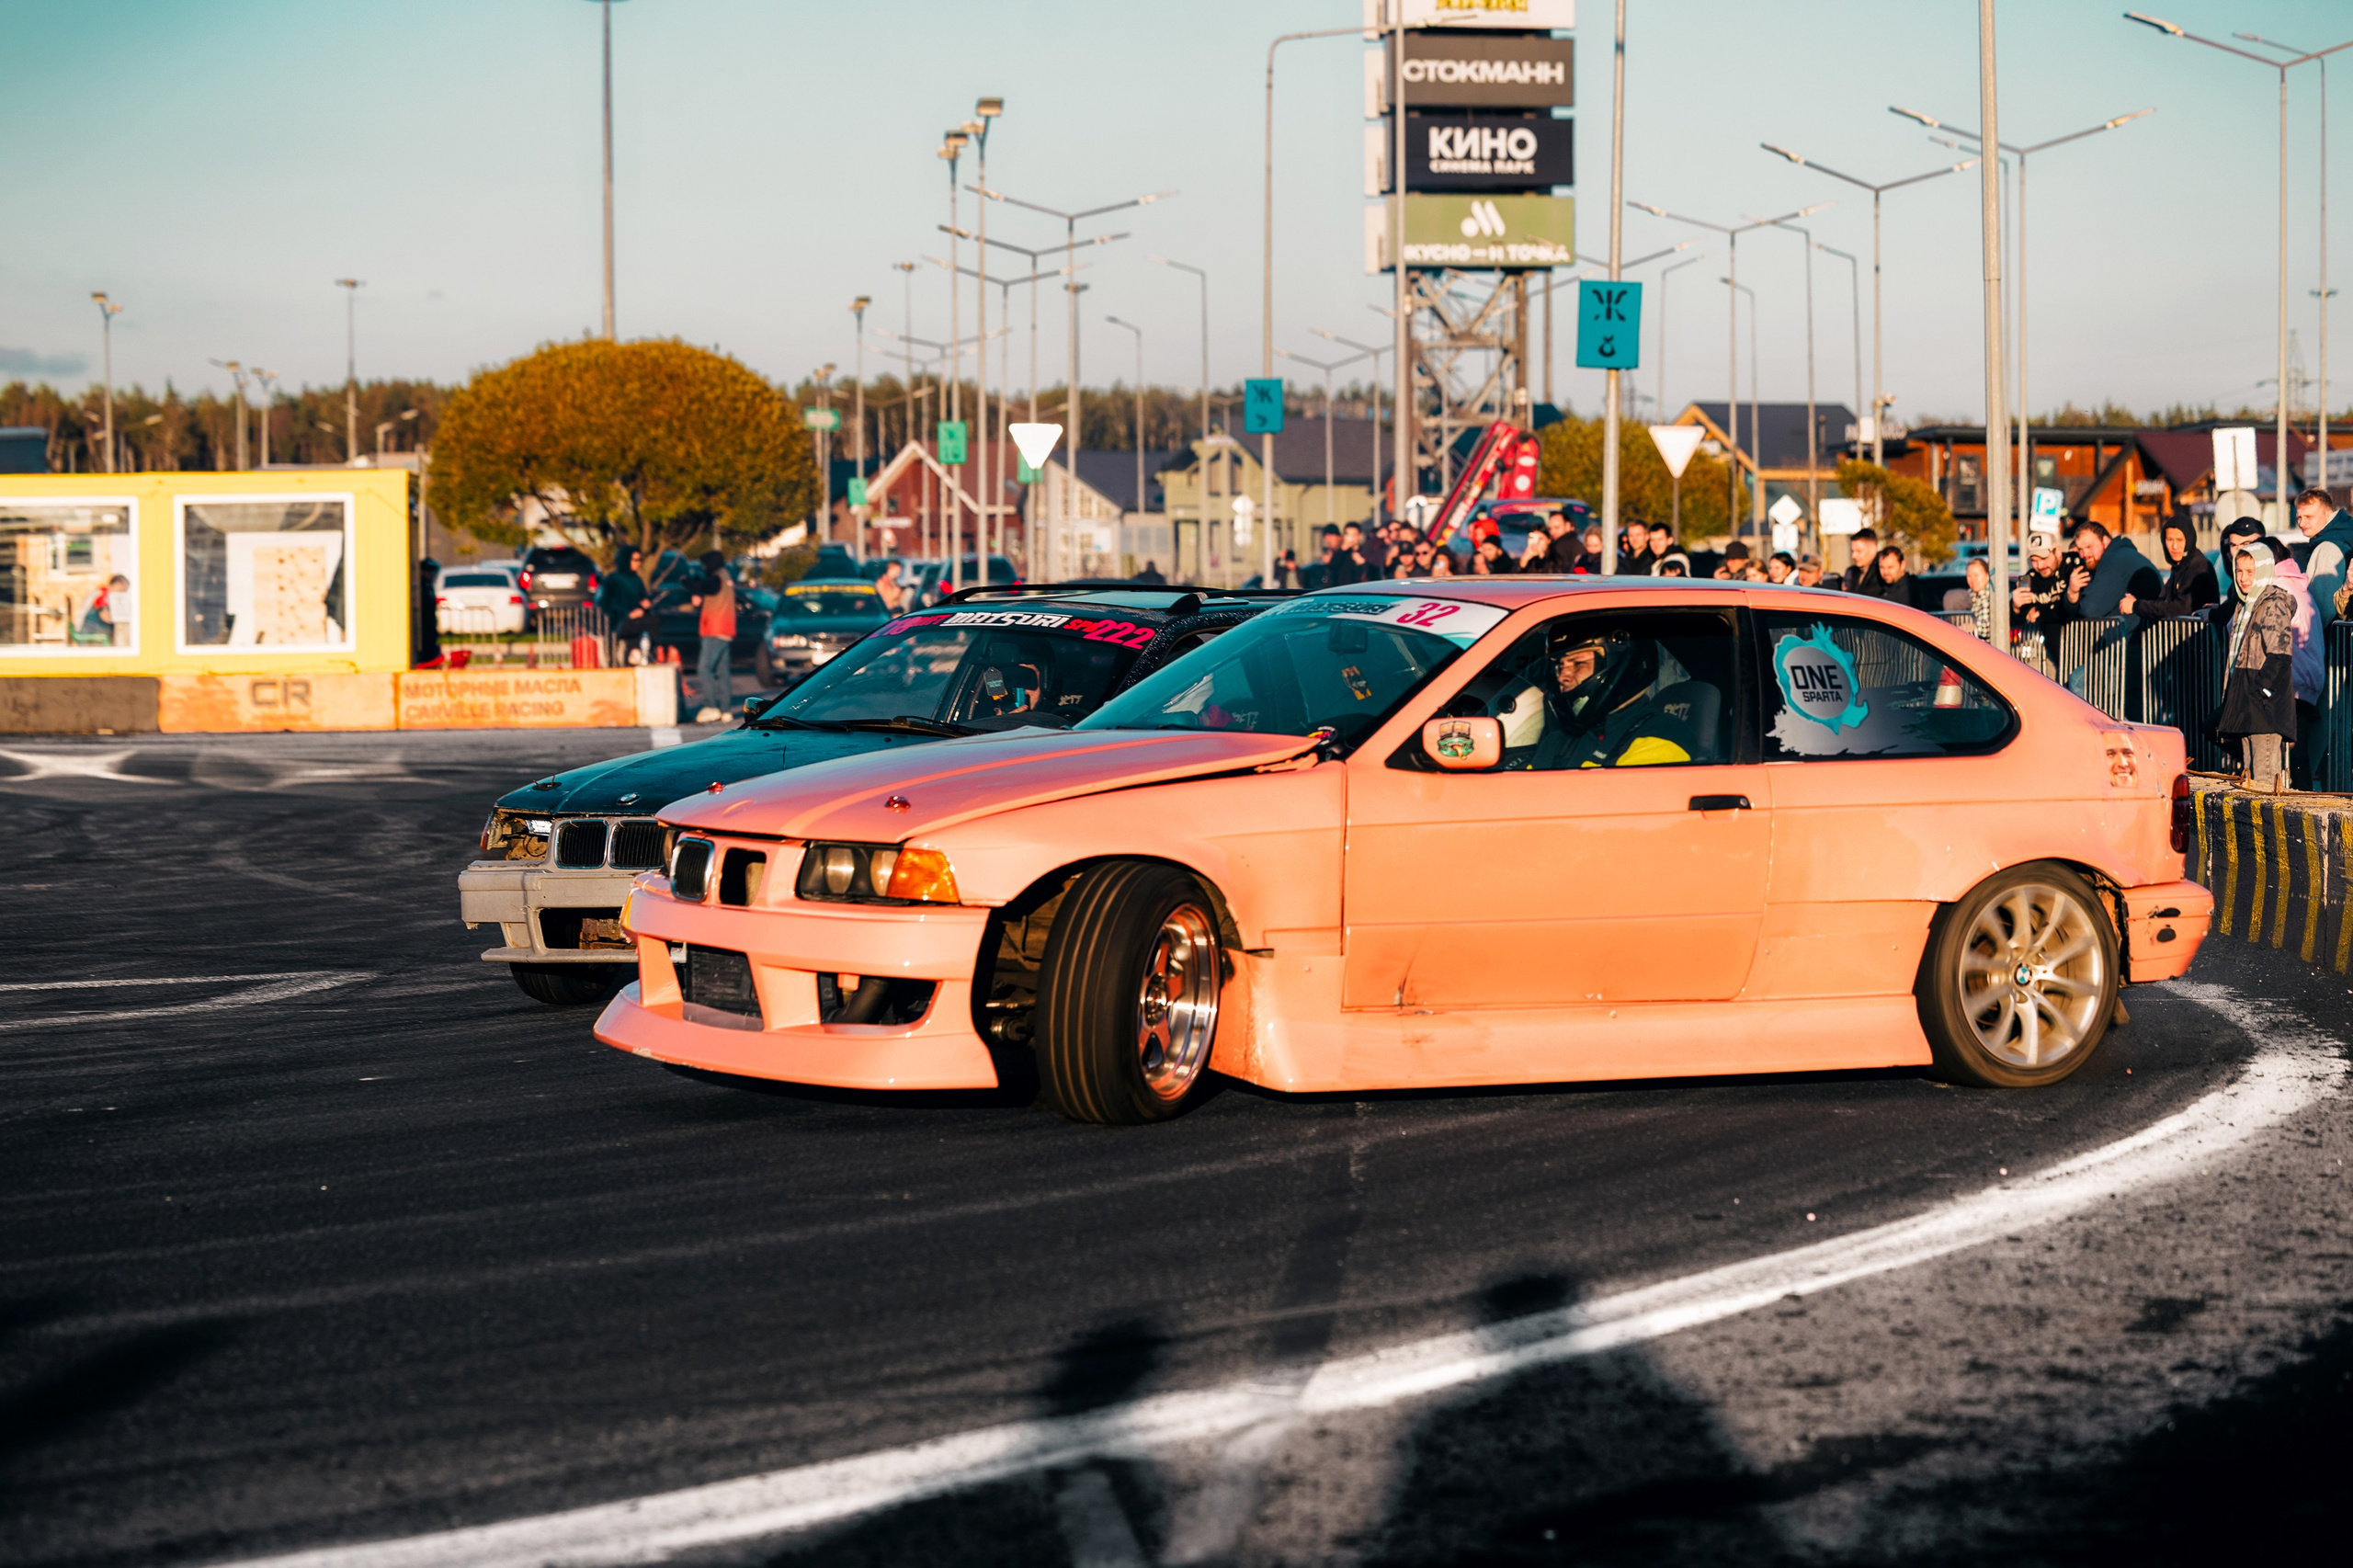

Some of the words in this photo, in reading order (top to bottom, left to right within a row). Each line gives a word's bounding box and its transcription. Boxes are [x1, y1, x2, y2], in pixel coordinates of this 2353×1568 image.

[1402, 59, 1565, 85] СТОКМАНН
[1428, 127, 1538, 161] КИНО
[1396, 602, 1461, 627] 32
[939, 611, 1074, 629] MATSURI
[1083, 619, 1157, 651] 222
[404, 679, 509, 699] МОТОРНЫЕ
[514, 678, 582, 695] МАСЛА
[1790, 665, 1843, 689] ONE
[251, 680, 312, 706] CR
[1802, 690, 1844, 703] SPARTA
[494, 699, 566, 718] RACING
